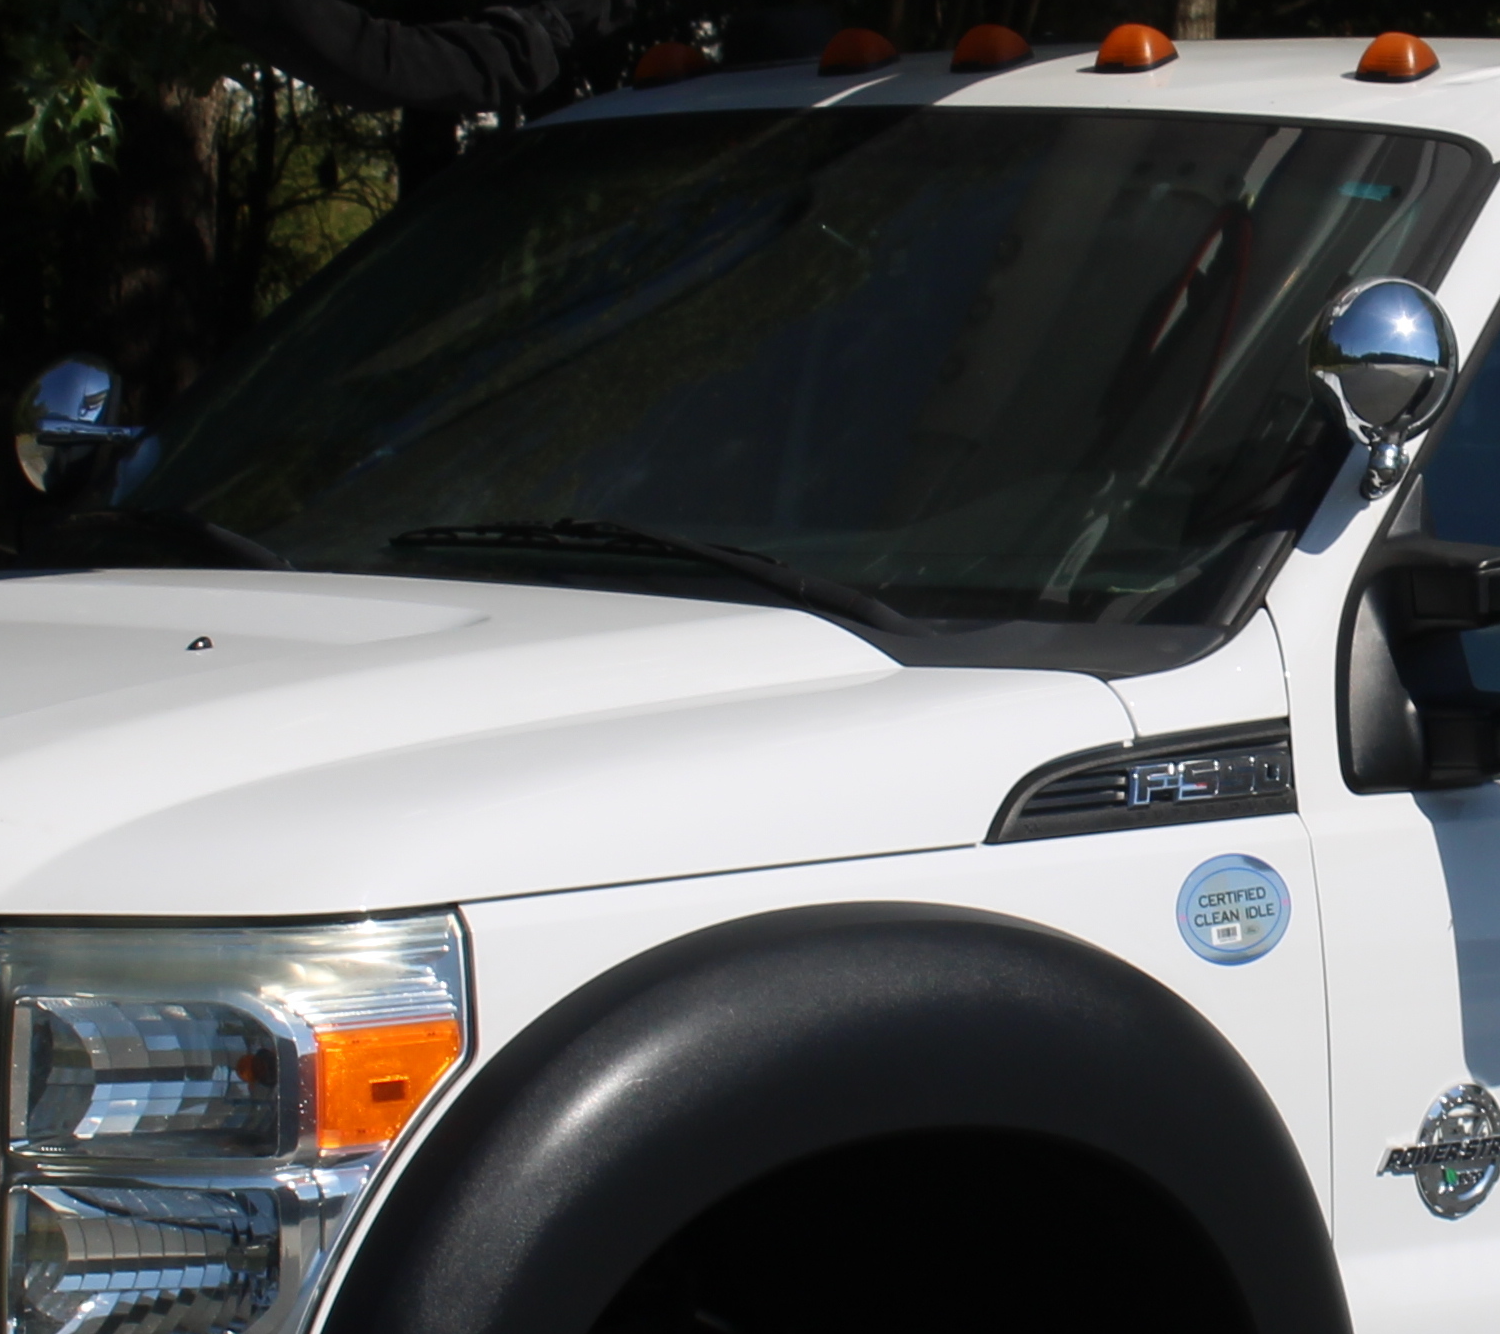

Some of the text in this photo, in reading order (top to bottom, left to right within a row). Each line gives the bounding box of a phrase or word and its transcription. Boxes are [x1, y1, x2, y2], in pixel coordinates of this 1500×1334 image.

[1198, 886, 1266, 909] CERTIFIED
[1194, 903, 1276, 928] CLEAN IDLE
